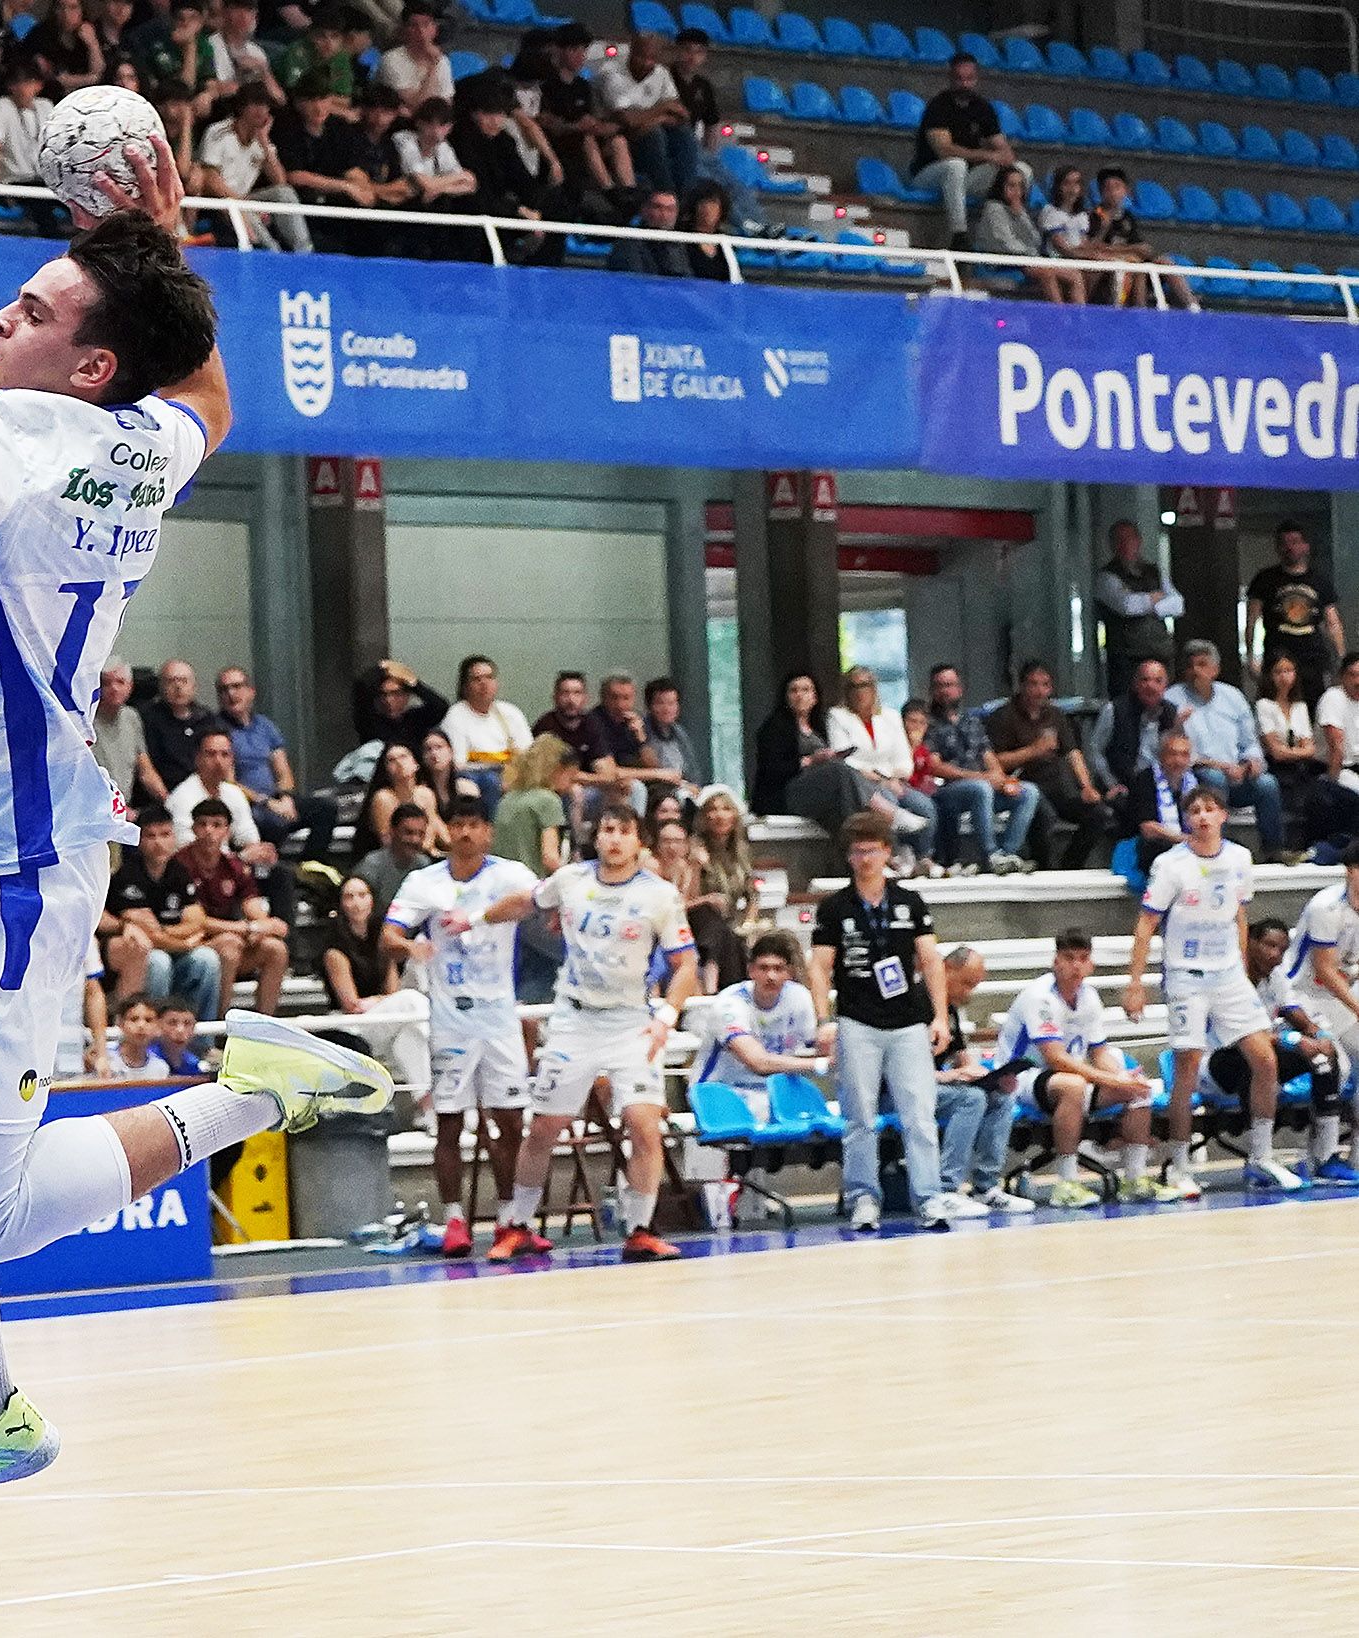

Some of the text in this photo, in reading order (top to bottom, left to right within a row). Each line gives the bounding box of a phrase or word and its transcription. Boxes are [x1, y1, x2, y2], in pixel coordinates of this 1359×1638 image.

[341, 330, 416, 360] Concello
[343, 361, 468, 391] de Pontevedra
[71, 516, 95, 552] Y.
